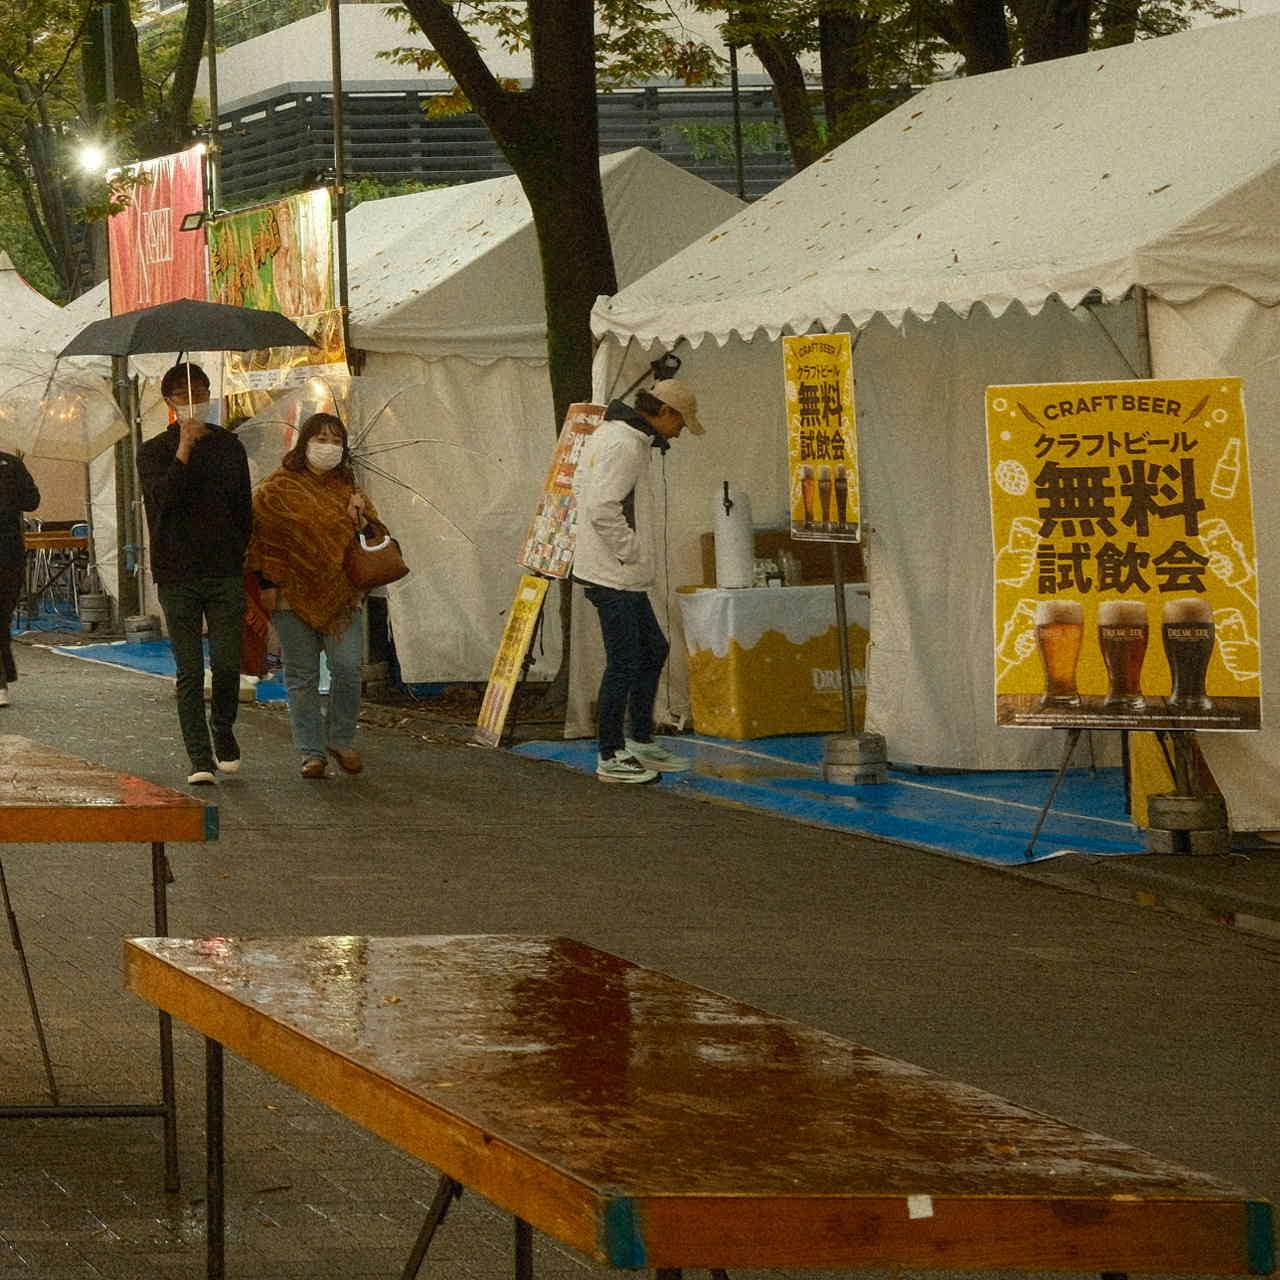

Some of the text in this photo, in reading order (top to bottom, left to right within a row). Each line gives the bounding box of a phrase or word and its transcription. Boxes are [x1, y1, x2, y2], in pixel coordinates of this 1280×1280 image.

[797, 364, 840, 380] クラフトビール
[798, 380, 843, 427] 無料
[1043, 395, 1182, 420] CRAFT BEER
[799, 428, 845, 461] 試飲会
[1034, 430, 1198, 459] クラフトビール
[1034, 458, 1206, 538] 無料
[1036, 540, 1210, 595] 試飲会
